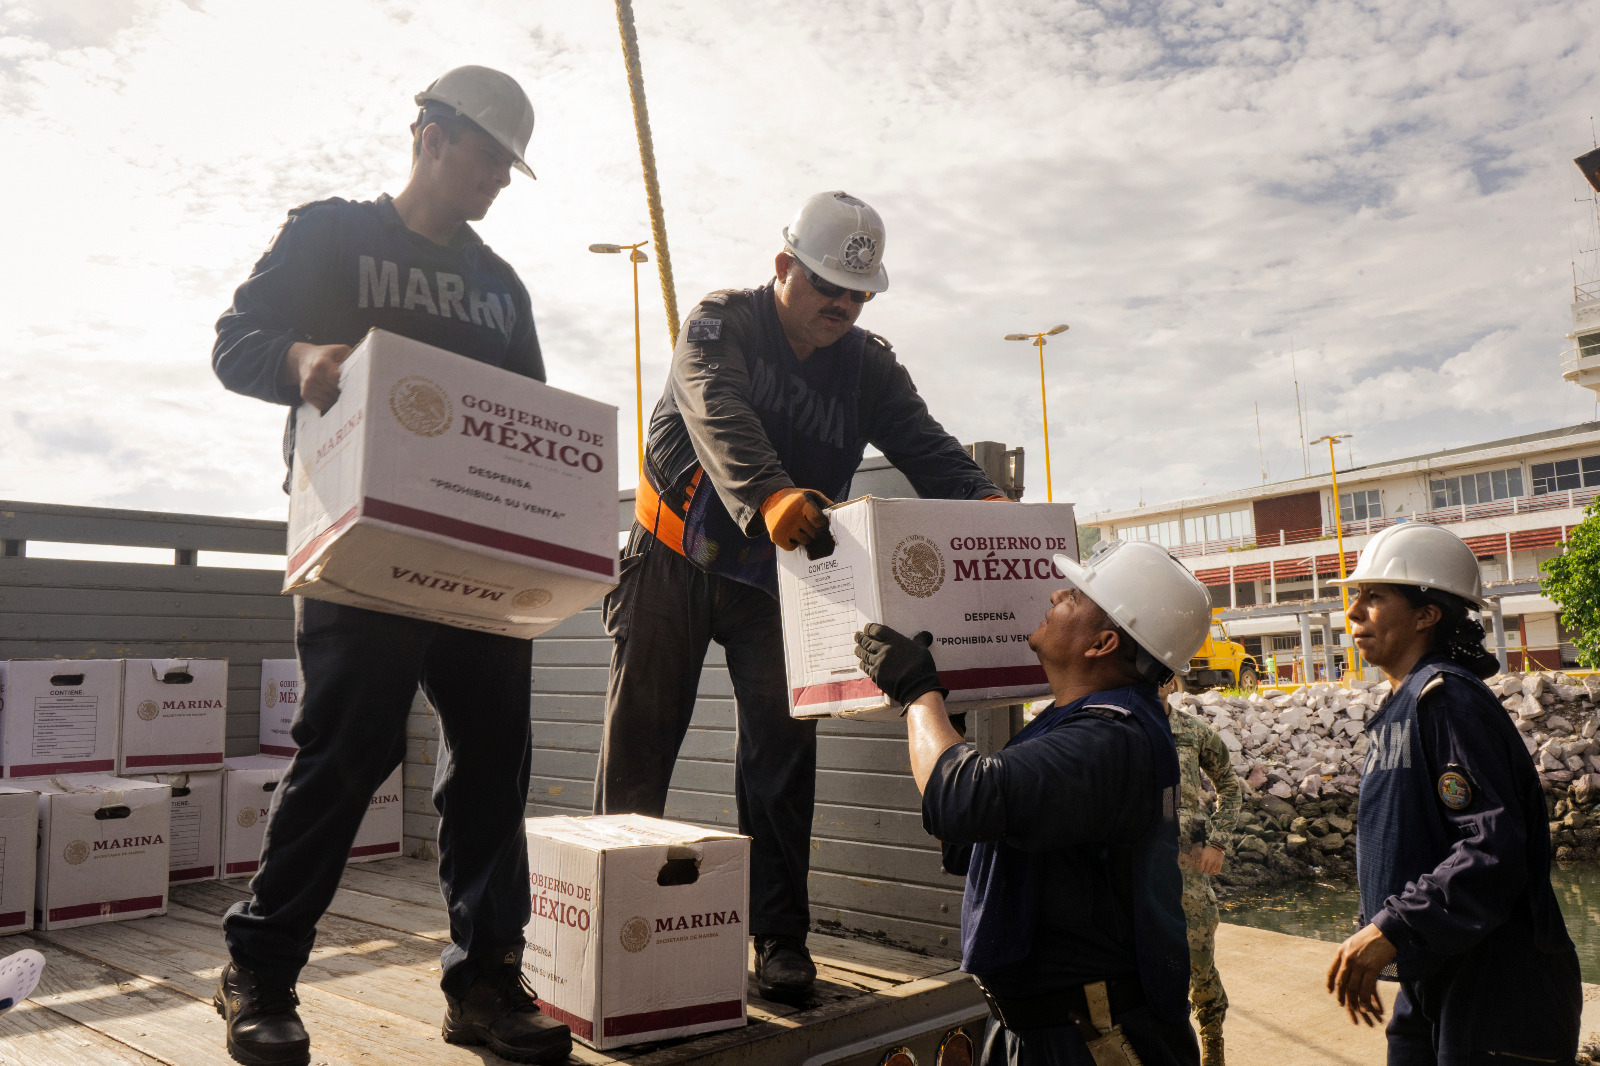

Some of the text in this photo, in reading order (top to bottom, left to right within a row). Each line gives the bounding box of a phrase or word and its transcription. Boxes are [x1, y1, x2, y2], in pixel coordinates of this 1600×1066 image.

[461, 394, 573, 437] GOBIERNO
[577, 428, 604, 448] DE
[460, 414, 604, 473] MÉXICO
[468, 465, 532, 490] DESPENSA
[504, 498, 520, 509] SU
[950, 536, 1066, 550] GOBIERNO DE
[391, 565, 506, 602] MARINA
[964, 612, 1016, 622] DESPENSA
[996, 635, 1008, 643] SU
[279, 680, 299, 688] GOBIER
[162, 699, 223, 709] MARINA
[278, 689, 298, 704] MÉX
[370, 794, 400, 805] RINA
[92, 834, 164, 851] MARINA
[577, 885, 591, 901] DE
[654, 910, 742, 933] MARINA
[526, 941, 552, 958] DESPENSA
